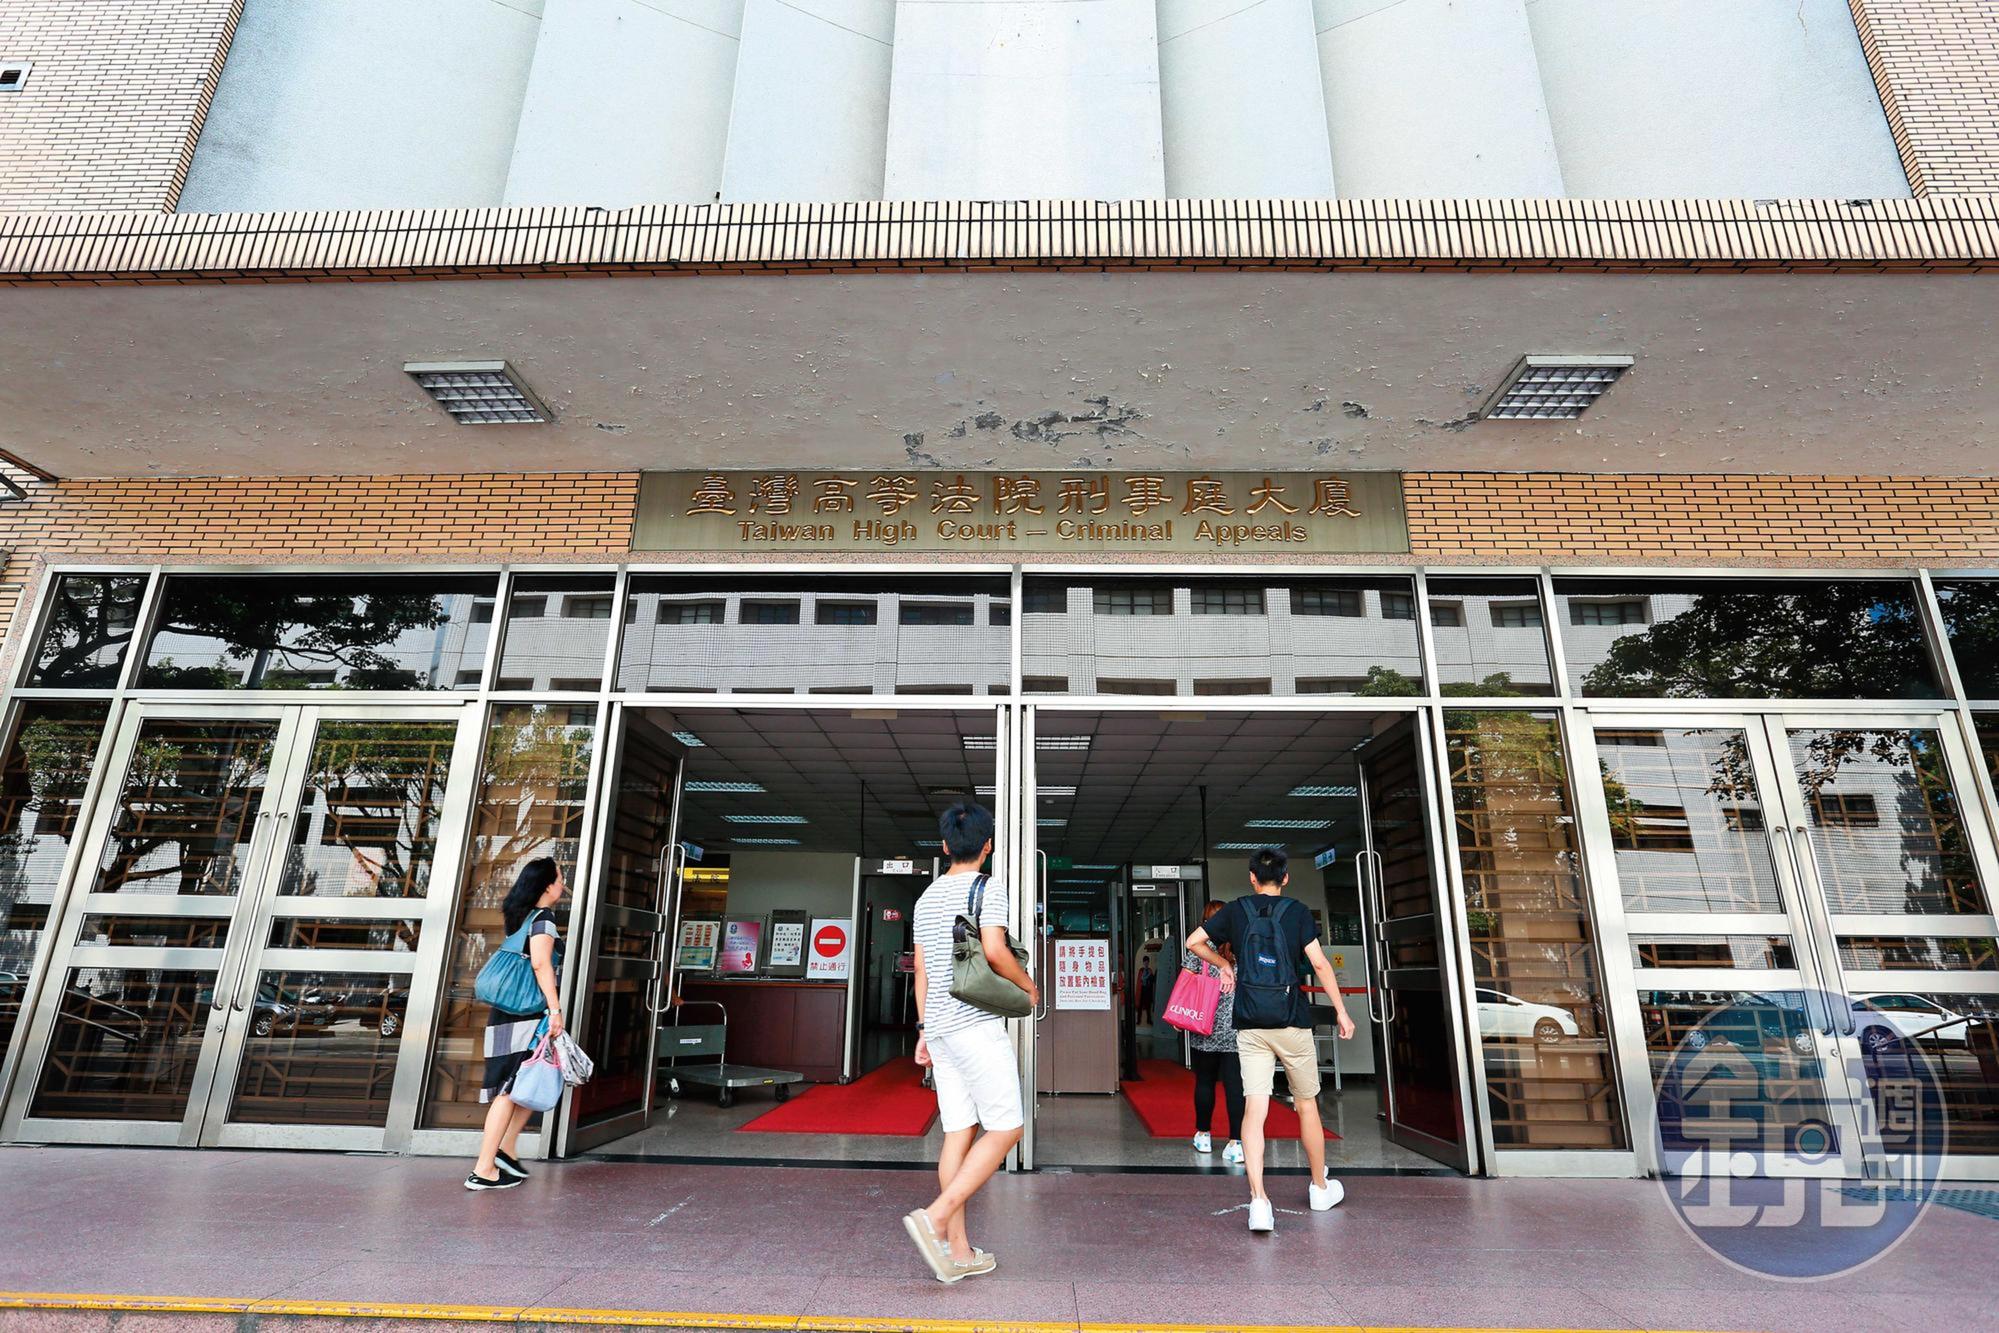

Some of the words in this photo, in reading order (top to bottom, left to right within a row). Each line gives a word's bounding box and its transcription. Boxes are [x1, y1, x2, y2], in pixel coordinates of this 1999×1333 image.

[686, 474, 1362, 518] 臺灣高等法院刑事庭大廈
[736, 520, 835, 541] Taiwan
[853, 520, 917, 546] High
[936, 519, 1017, 541] Court
[1055, 519, 1173, 542] Criminal
[1193, 519, 1308, 546] Appeals
[810, 962, 846, 971] 禁止通行
[1169, 1004, 1204, 1021] CLINIQUE
